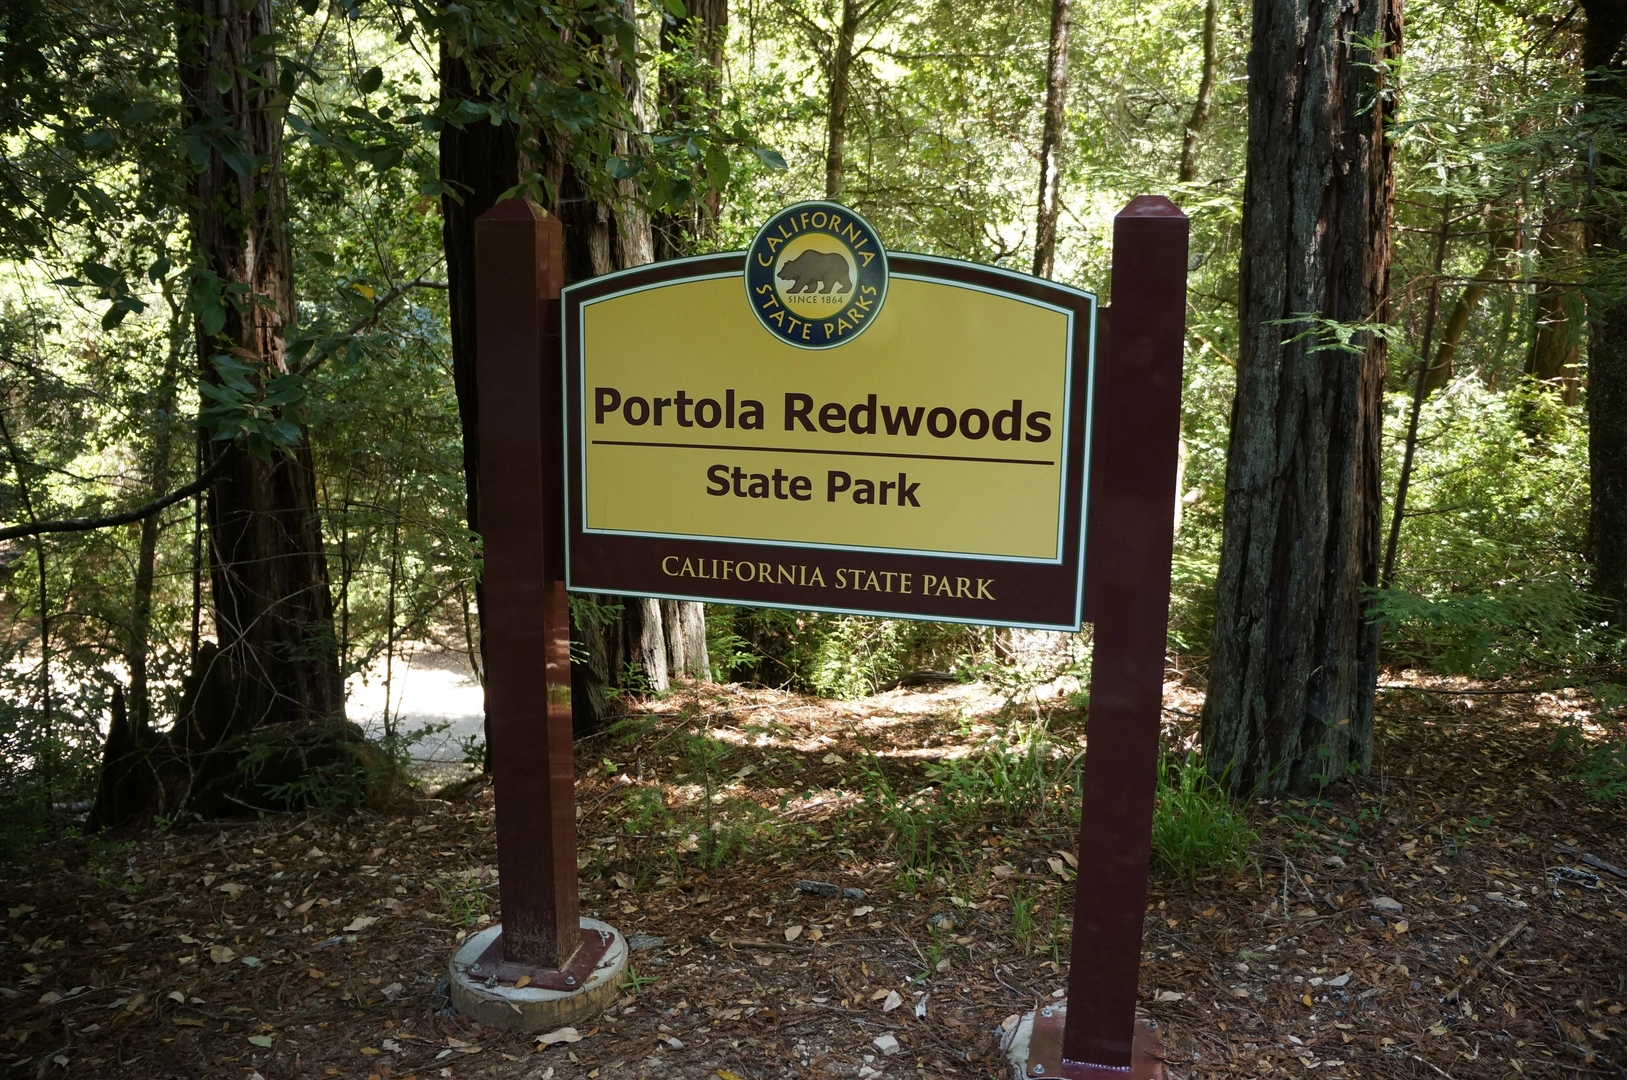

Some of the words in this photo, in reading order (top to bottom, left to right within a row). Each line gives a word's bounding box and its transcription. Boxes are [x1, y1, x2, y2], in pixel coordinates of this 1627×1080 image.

[758, 211, 876, 268] CALIFORNIA
[756, 284, 812, 340] STATE
[823, 285, 877, 339] PARKS
[788, 296, 817, 304] SINCE
[821, 296, 843, 304] 1864
[594, 387, 765, 430] Portola
[784, 392, 1052, 443] Redwoods
[706, 464, 812, 501] State
[827, 470, 921, 507] Park
[661, 555, 826, 588] CALIFORNIA
[835, 568, 912, 594] STATE
[923, 573, 996, 600] PARK
